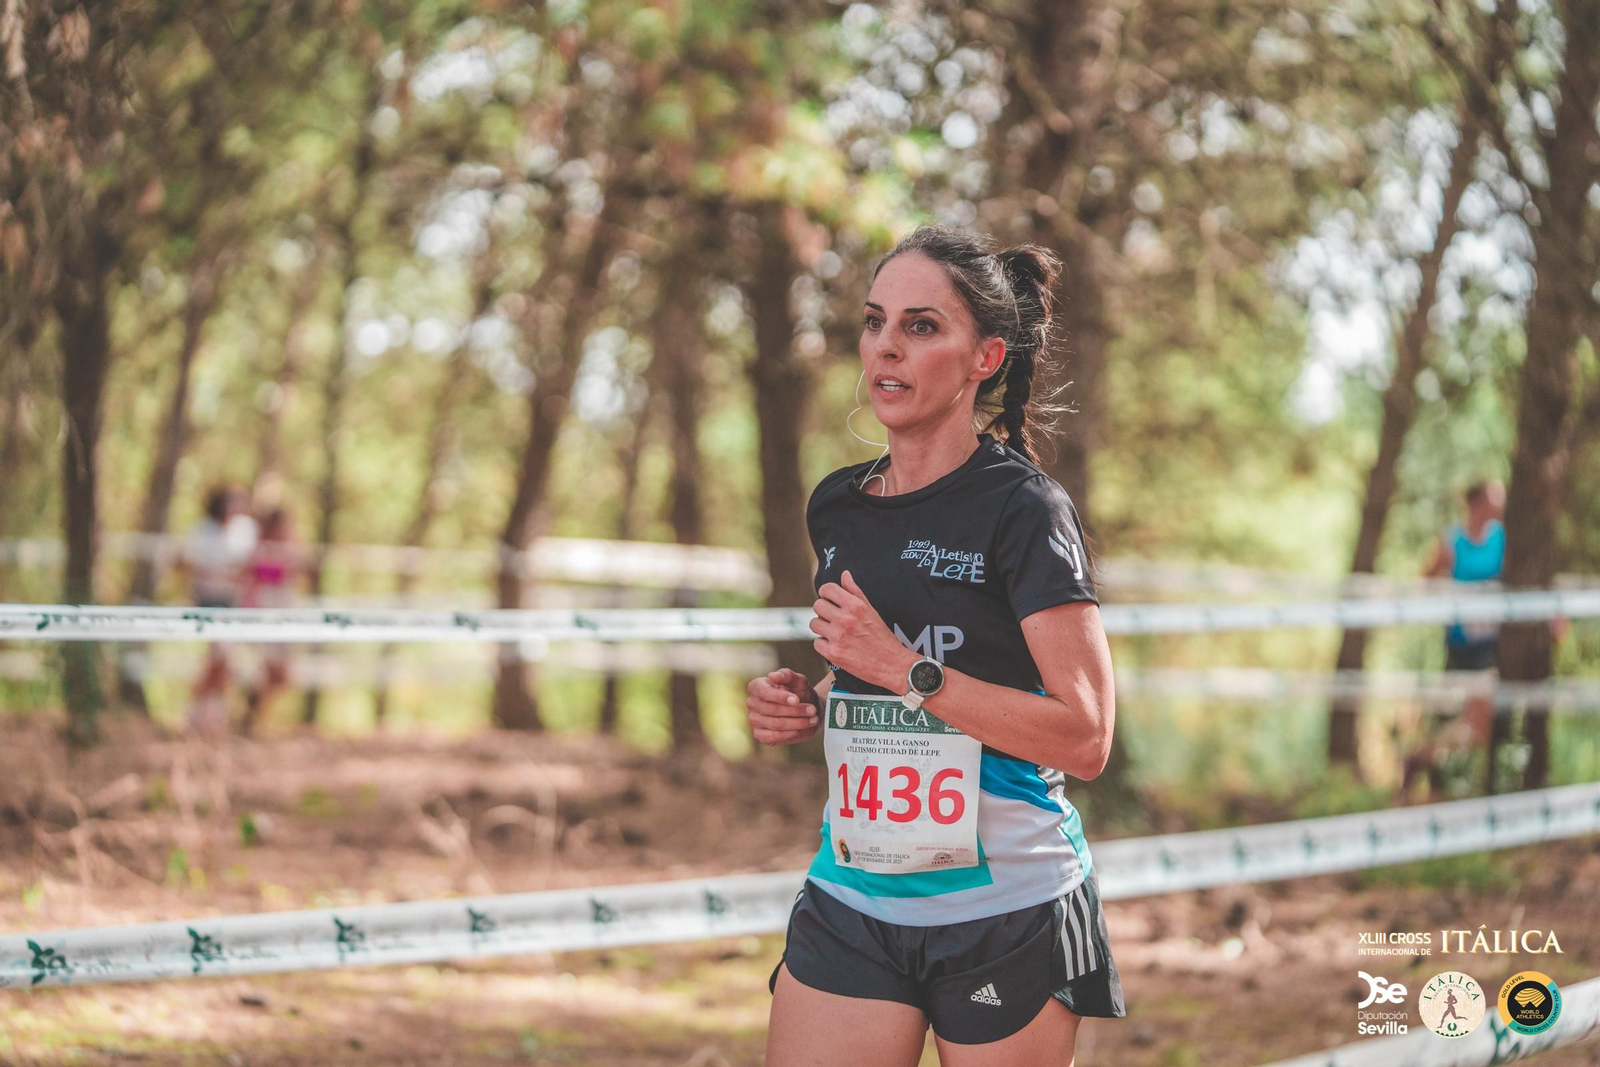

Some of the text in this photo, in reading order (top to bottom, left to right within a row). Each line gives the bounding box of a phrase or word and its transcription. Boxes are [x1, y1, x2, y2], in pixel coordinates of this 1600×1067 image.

[907, 539, 931, 549] 1999
[852, 703, 930, 727] ITÁLICA
[852, 737, 930, 747] BEATRIZ VILLA GANSO
[847, 746, 876, 754] ATLETISMO
[877, 747, 907, 755] CIUDAD
[920, 749, 941, 757] LEPE
[838, 763, 965, 825] 1436
[970, 994, 1002, 1006] adidas
